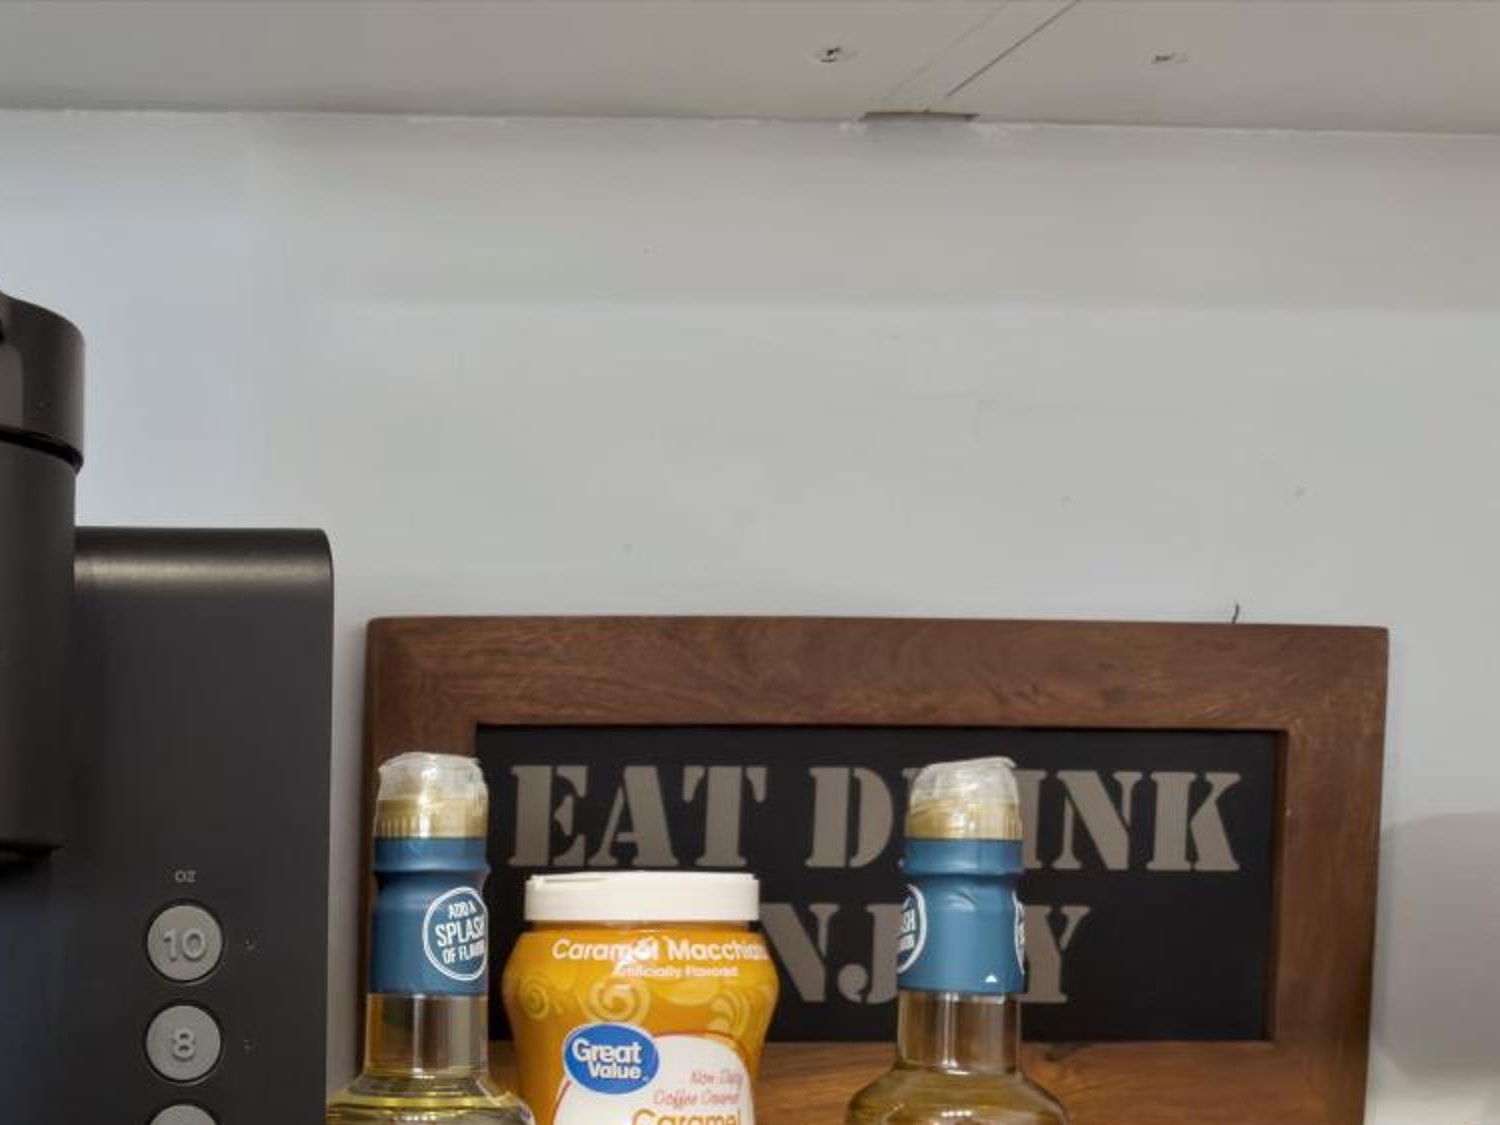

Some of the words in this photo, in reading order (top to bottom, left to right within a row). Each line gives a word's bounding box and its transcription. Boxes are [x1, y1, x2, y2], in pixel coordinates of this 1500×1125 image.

[508, 765, 767, 868] EAT
[805, 766, 1242, 872] DINK
[175, 870, 197, 883] OZ
[163, 927, 207, 963] 10
[442, 945, 457, 965] OF
[552, 937, 660, 961] Caramel
[758, 902, 1091, 1004] NJY
[171, 1028, 197, 1061] 8
[572, 1038, 642, 1064] Great
[588, 1059, 642, 1080] Value
